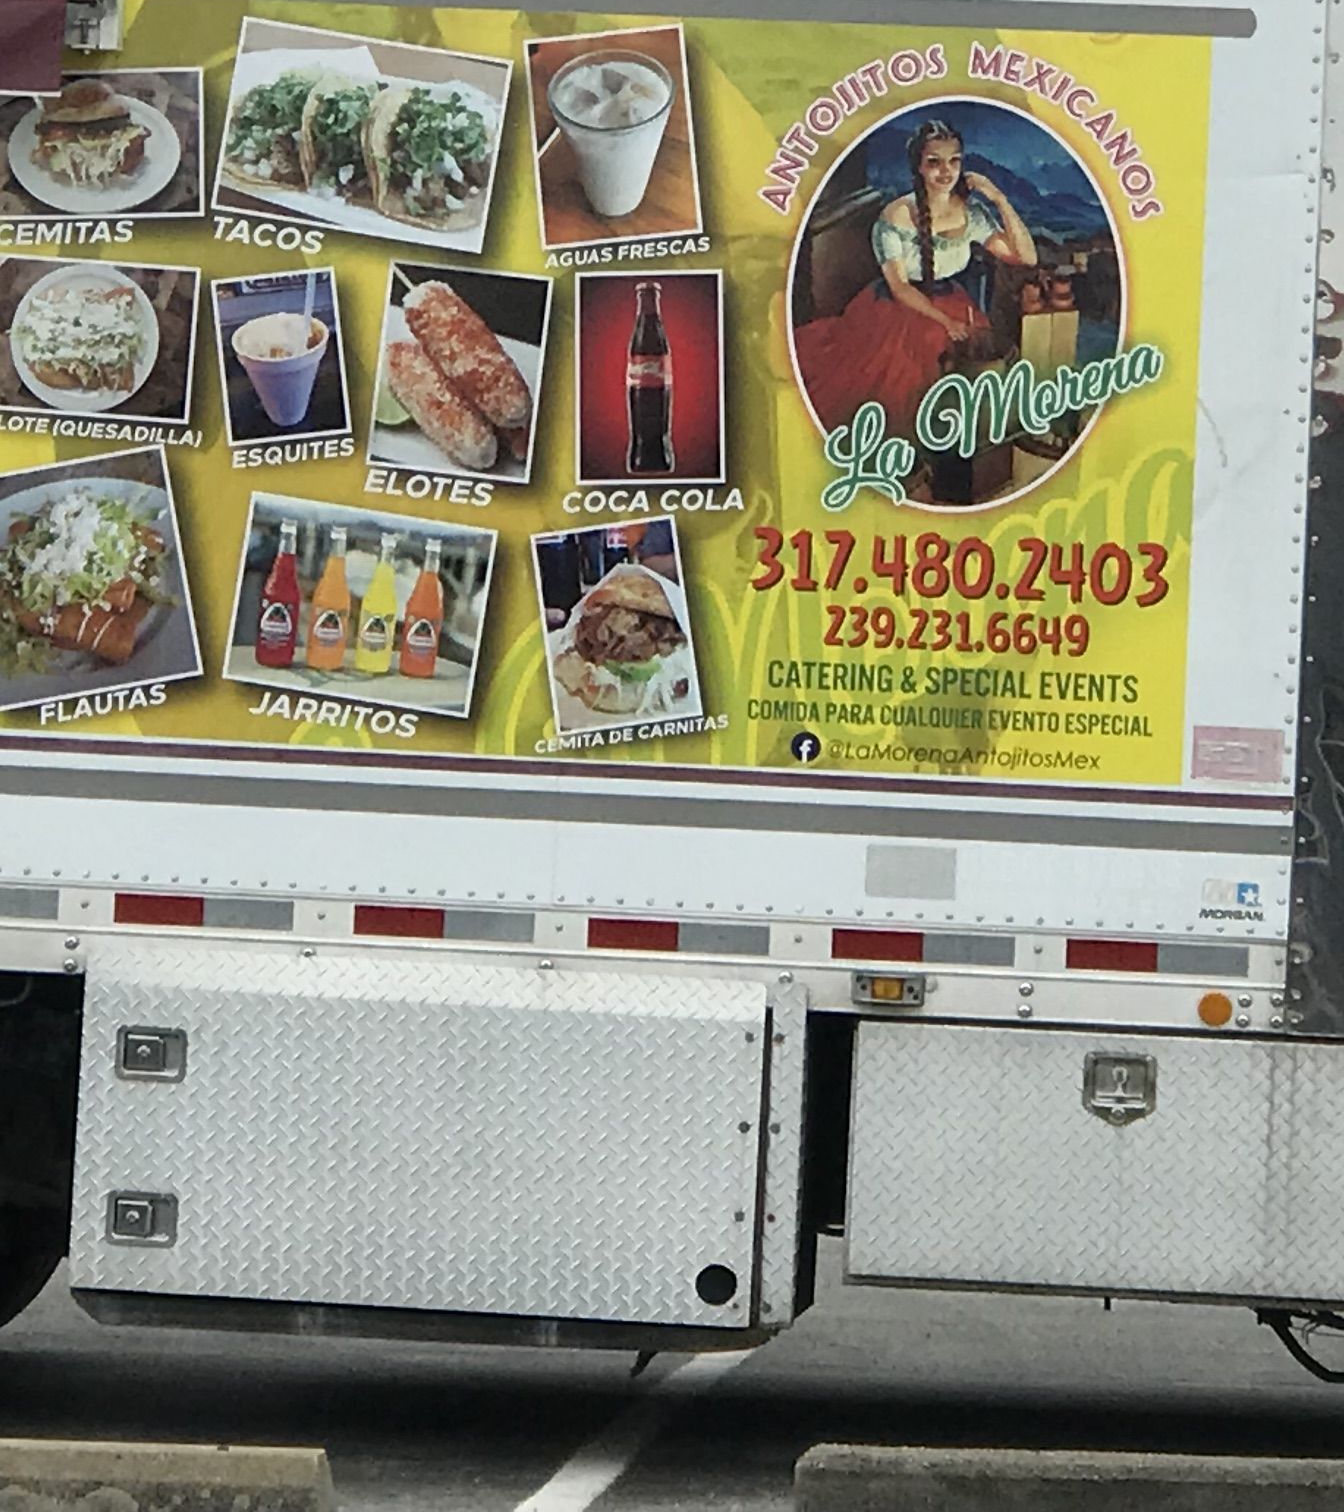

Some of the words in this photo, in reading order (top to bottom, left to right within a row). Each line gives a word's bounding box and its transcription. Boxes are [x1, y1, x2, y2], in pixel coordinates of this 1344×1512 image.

[759, 43, 947, 214] ANTOJITOS
[968, 41, 1162, 220] MEXICANOS
[213, 215, 325, 255] TACOS
[546, 246, 614, 268] AGUAS
[618, 237, 710, 261] FRESCAS
[52, 419, 203, 448] (QUESADILLA)
[822, 401, 917, 511] La
[919, 344, 1163, 458] Morena
[231, 438, 355, 469] ESQUITES
[364, 470, 493, 506] ELOTES
[561, 490, 650, 514] COCA
[659, 488, 745, 513] COLA
[751, 526, 1170, 607] 317.480.2403
[823, 605, 1091, 657] 239.231.6649
[766, 660, 894, 694] CATERING
[900, 669, 918, 695] &
[924, 669, 1032, 700] SPECIAL
[1039, 672, 1139, 703] EVENTS
[39, 684, 168, 725] FLAUTAS
[247, 690, 419, 739] JARRITOS
[746, 699, 821, 723] COMIDA
[824, 703, 876, 727] PARA
[879, 706, 983, 732] CUALQUIER
[987, 710, 1060, 734] EVENTO
[1065, 713, 1153, 738] ESPECIAL
[534, 731, 607, 754] CEMITA
[609, 727, 633, 745] DE
[636, 714, 730, 742] CARNITAS
[829, 740, 1102, 772] @LaMorenaAntojitosMex
[1199, 908, 1264, 922] MORGAN
